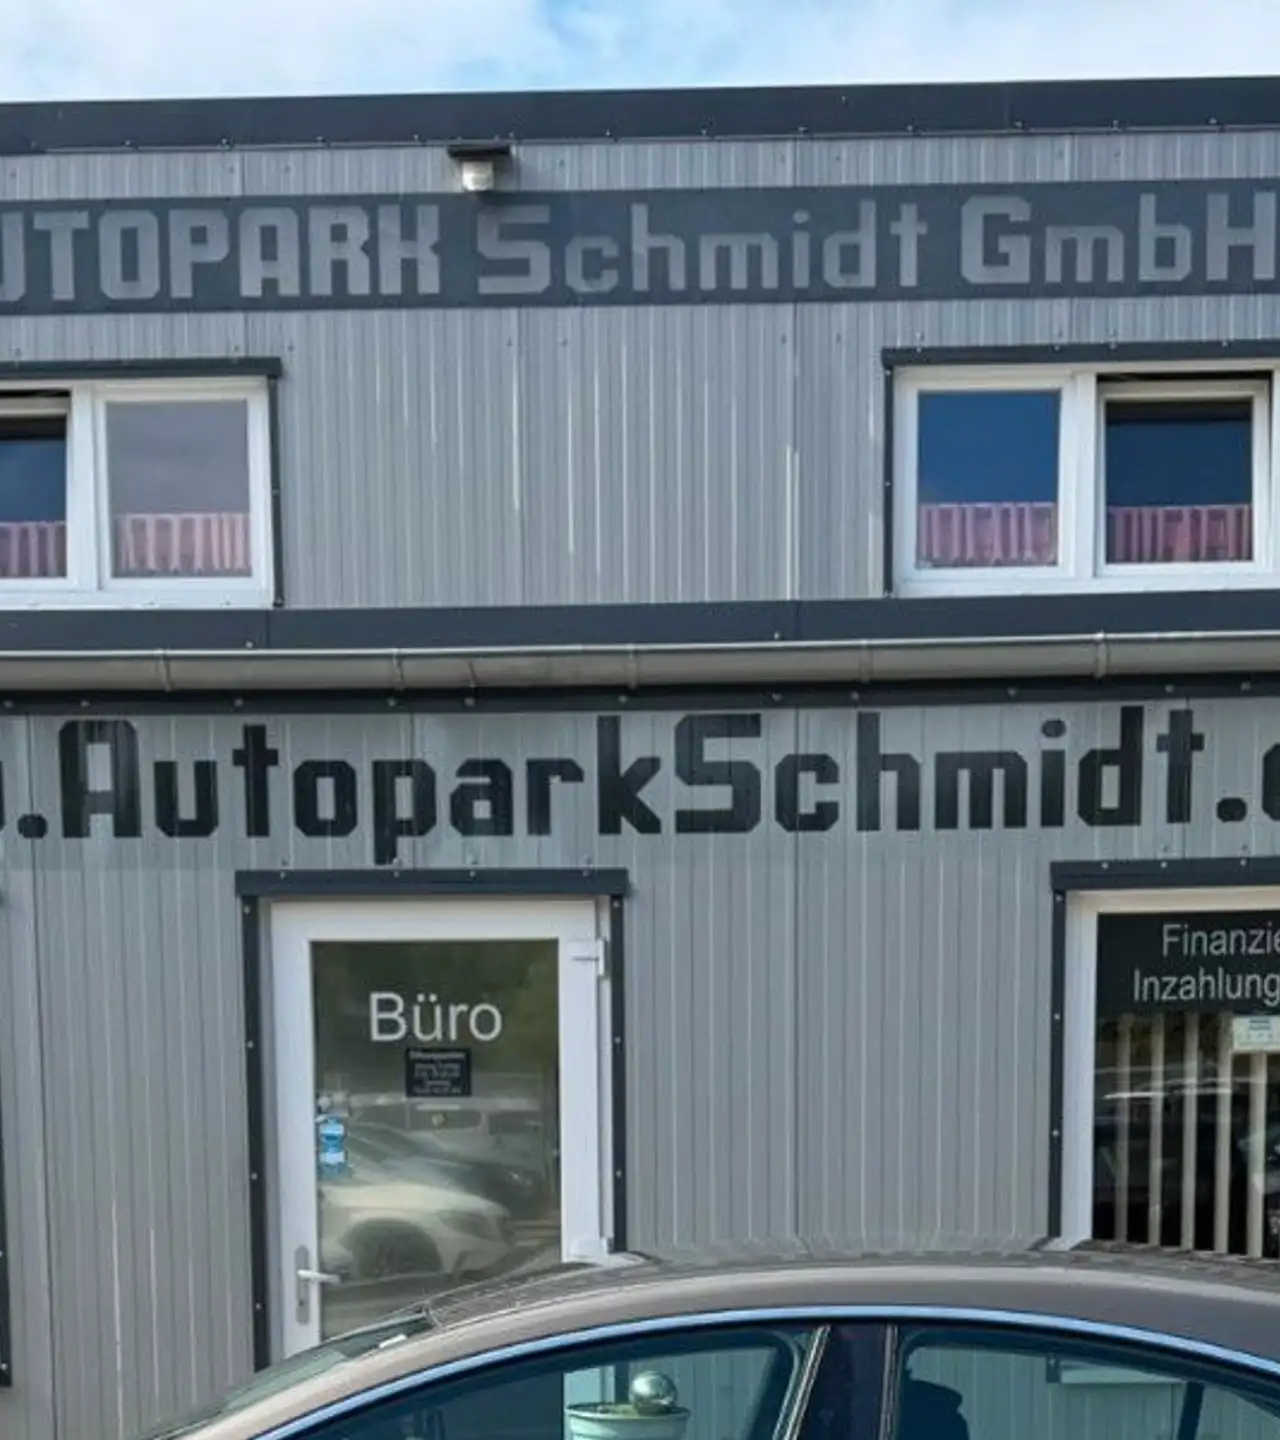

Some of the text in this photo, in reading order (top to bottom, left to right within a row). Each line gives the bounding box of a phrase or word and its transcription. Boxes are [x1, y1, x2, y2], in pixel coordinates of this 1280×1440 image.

[477, 198, 928, 295] Schmidt
[960, 191, 1277, 285] GmbH
[368, 991, 503, 1042] Büro
